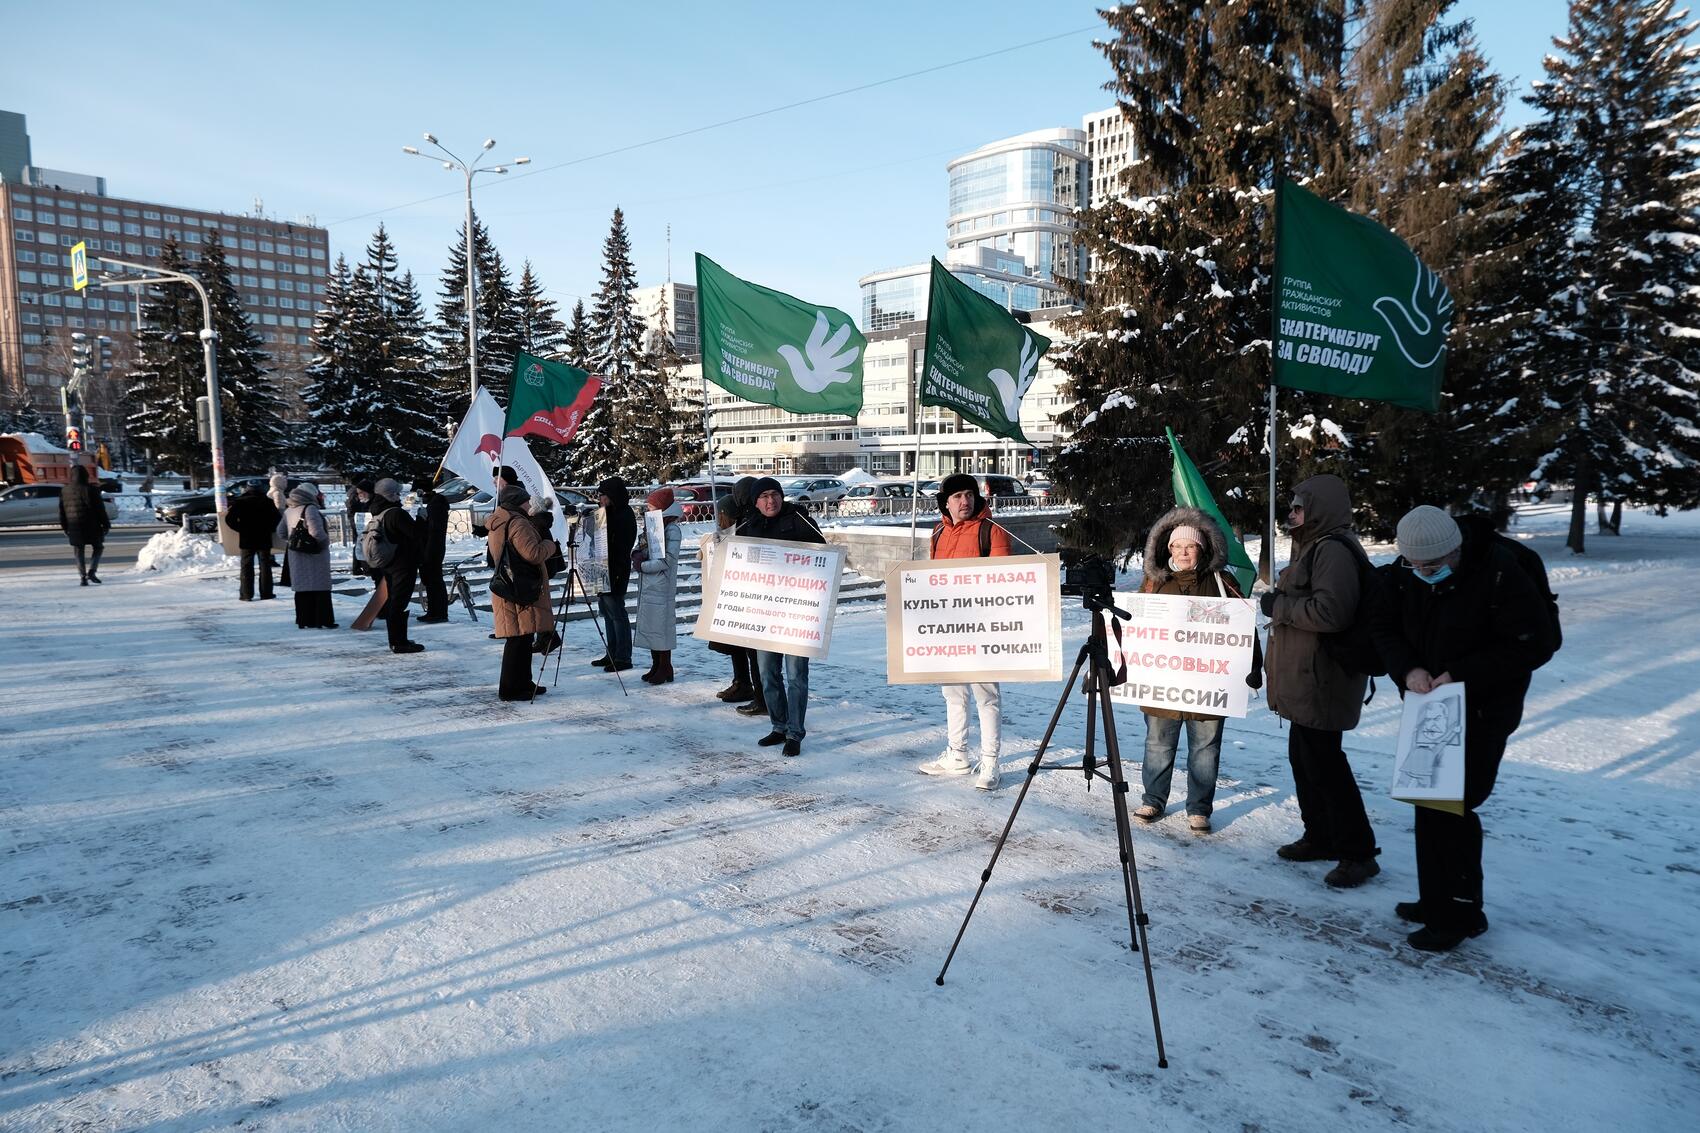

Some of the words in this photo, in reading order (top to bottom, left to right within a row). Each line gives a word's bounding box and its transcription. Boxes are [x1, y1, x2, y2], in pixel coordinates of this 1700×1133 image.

[1283, 277, 1312, 290] ГРУППА
[1282, 288, 1342, 307] ГРАЖДАНСКИХ
[1281, 300, 1332, 317] АКТИВИСТОВ
[1280, 318, 1381, 351] ЕКАТЕРИНБУРГ
[1278, 340, 1294, 360] ЗА
[1296, 343, 1374, 375] СВОБОДУ
[721, 361, 731, 376] ЗА
[731, 368, 776, 391] СВОБОДУ
[929, 364, 991, 408] ЕКАТЕРИНБУРГ
[784, 552, 811, 566] ТРИ
[724, 570, 828, 591] КОМАНДУЮЩИХ
[929, 573, 948, 586] 65
[953, 574, 982, 585] ЛЕТ
[986, 571, 1037, 584] НАЗАД
[740, 591, 762, 601] БЫЛИ
[903, 599, 948, 610] КУЛЬТ
[713, 618, 725, 627] ПО
[727, 620, 766, 632] ПРИКАЗУ
[769, 625, 821, 641] СТАЛИНА
[918, 623, 986, 635] СТАЛИНА
[990, 621, 1023, 632] БЫЛ
[1174, 630, 1252, 648] СИМВОЛ
[906, 645, 977, 657] ОСУЖДЕН
[1110, 682, 1229, 709] ЕПРЕССИЙ
